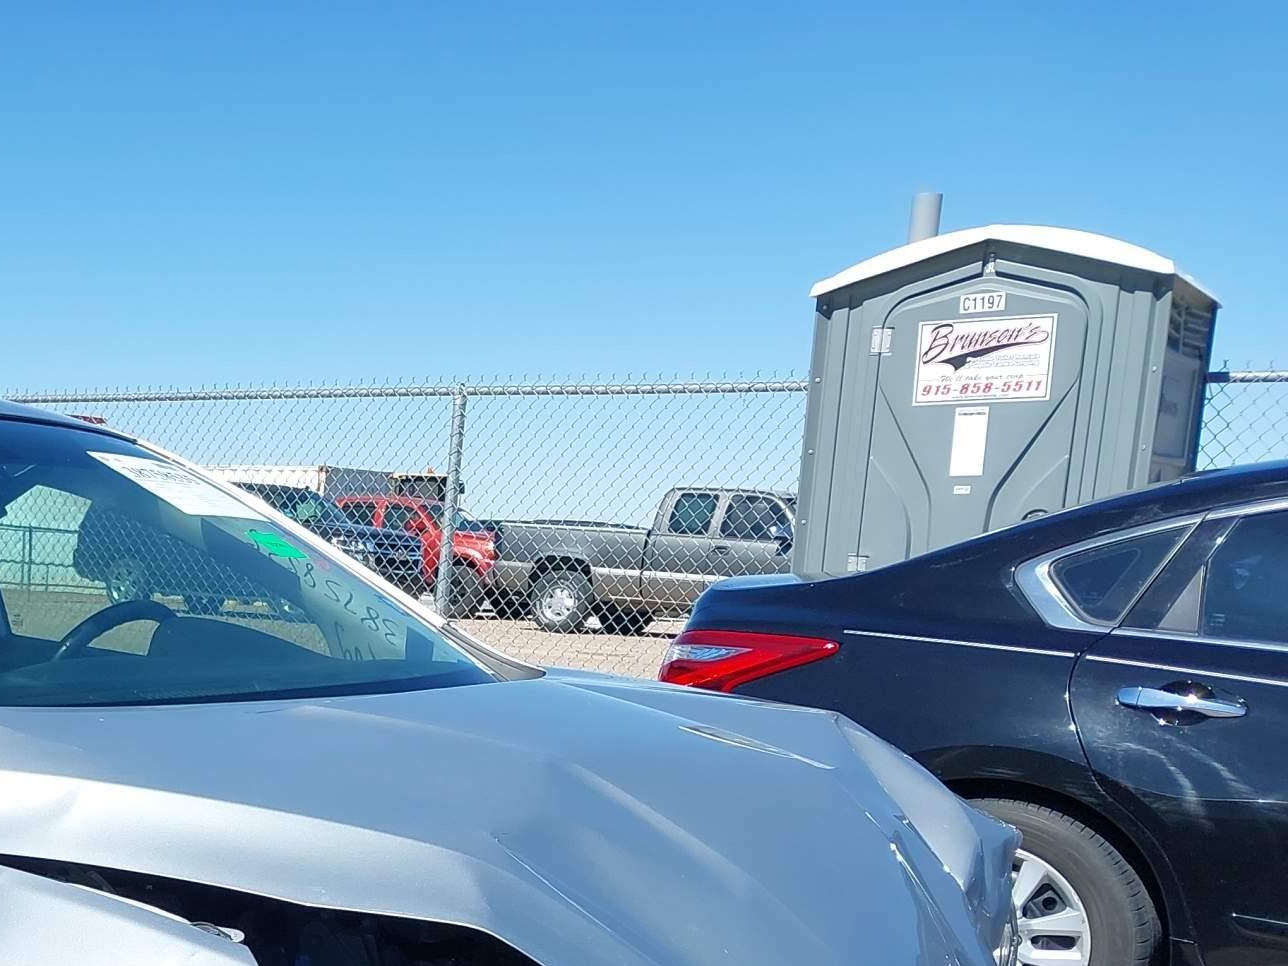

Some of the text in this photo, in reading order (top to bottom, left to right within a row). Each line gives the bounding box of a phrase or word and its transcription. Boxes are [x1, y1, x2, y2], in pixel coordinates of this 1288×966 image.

[963, 296, 1003, 311] C1197
[923, 323, 1048, 363] Brunson's
[922, 380, 1041, 396] 915-858-5511
